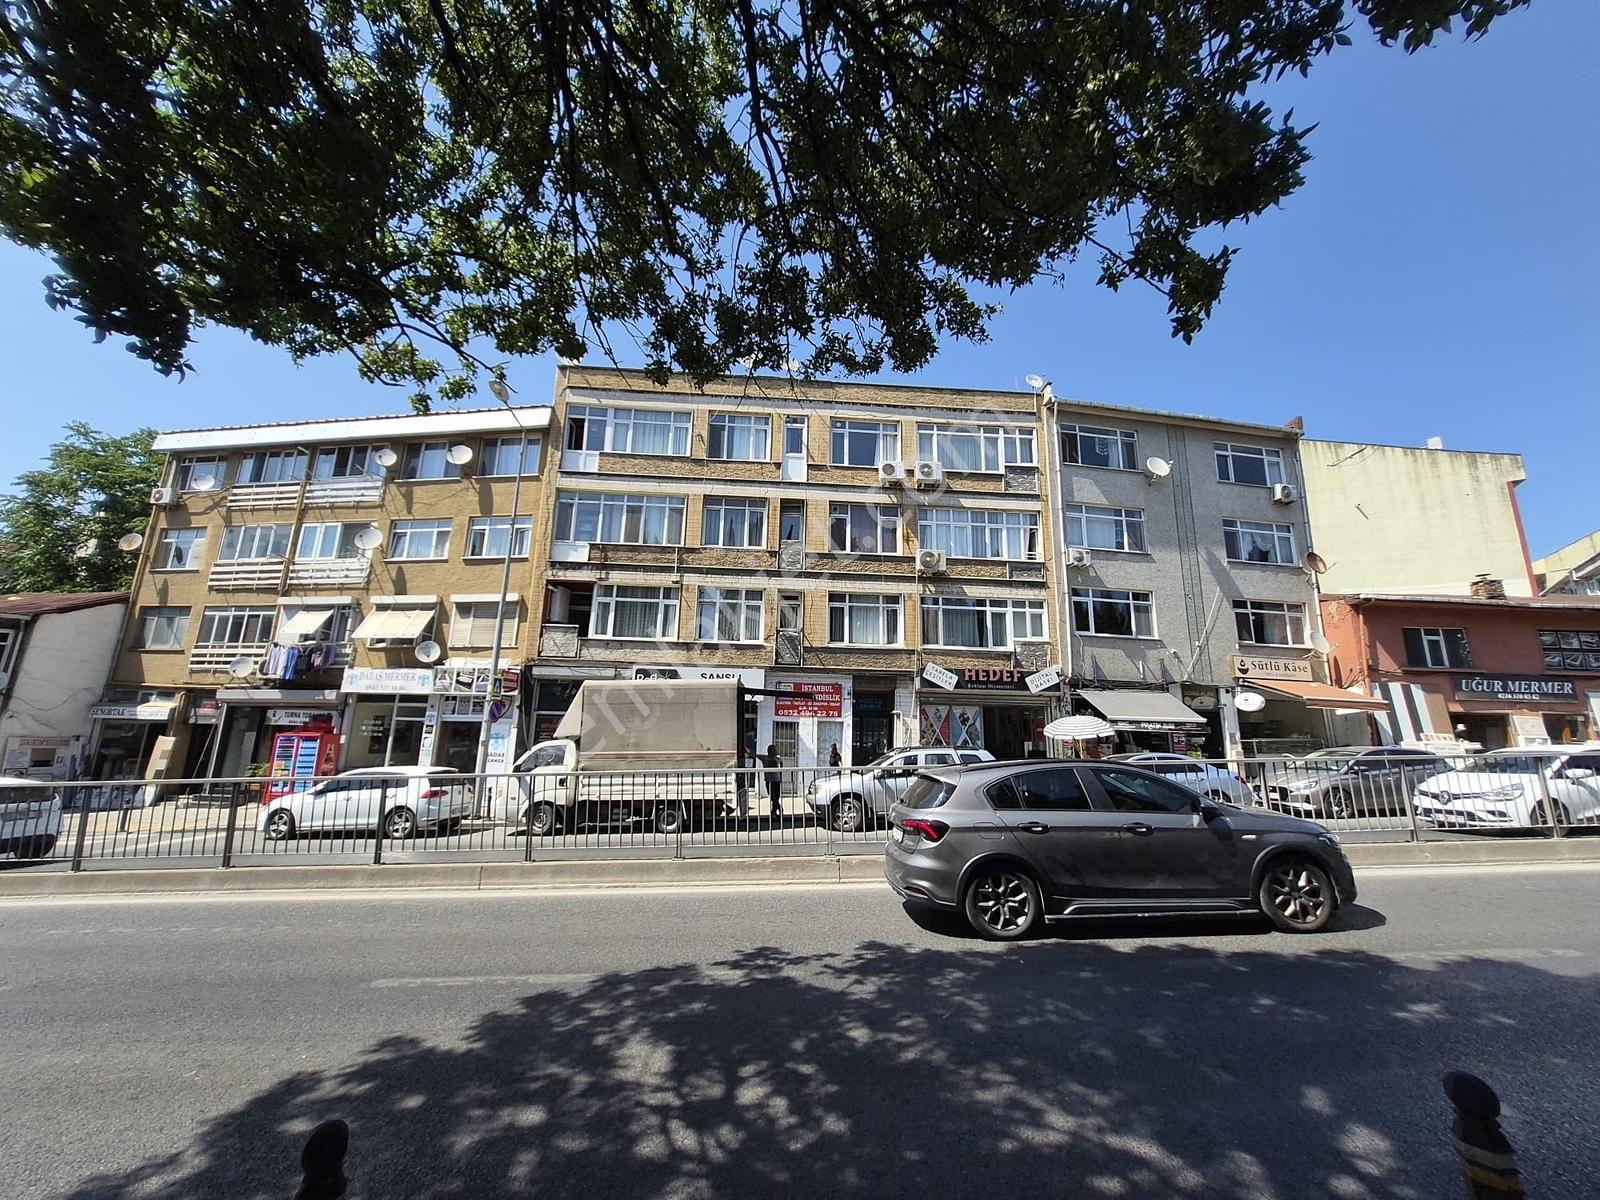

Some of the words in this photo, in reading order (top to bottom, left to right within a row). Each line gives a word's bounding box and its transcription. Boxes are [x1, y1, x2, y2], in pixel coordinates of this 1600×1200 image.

[964, 667, 1022, 682] HEDEF
[801, 684, 834, 692] İSTANBUL
[1034, 677, 1054, 689] BASKI
[1461, 677, 1504, 692] UĞUR
[1507, 681, 1574, 694] MERMER
